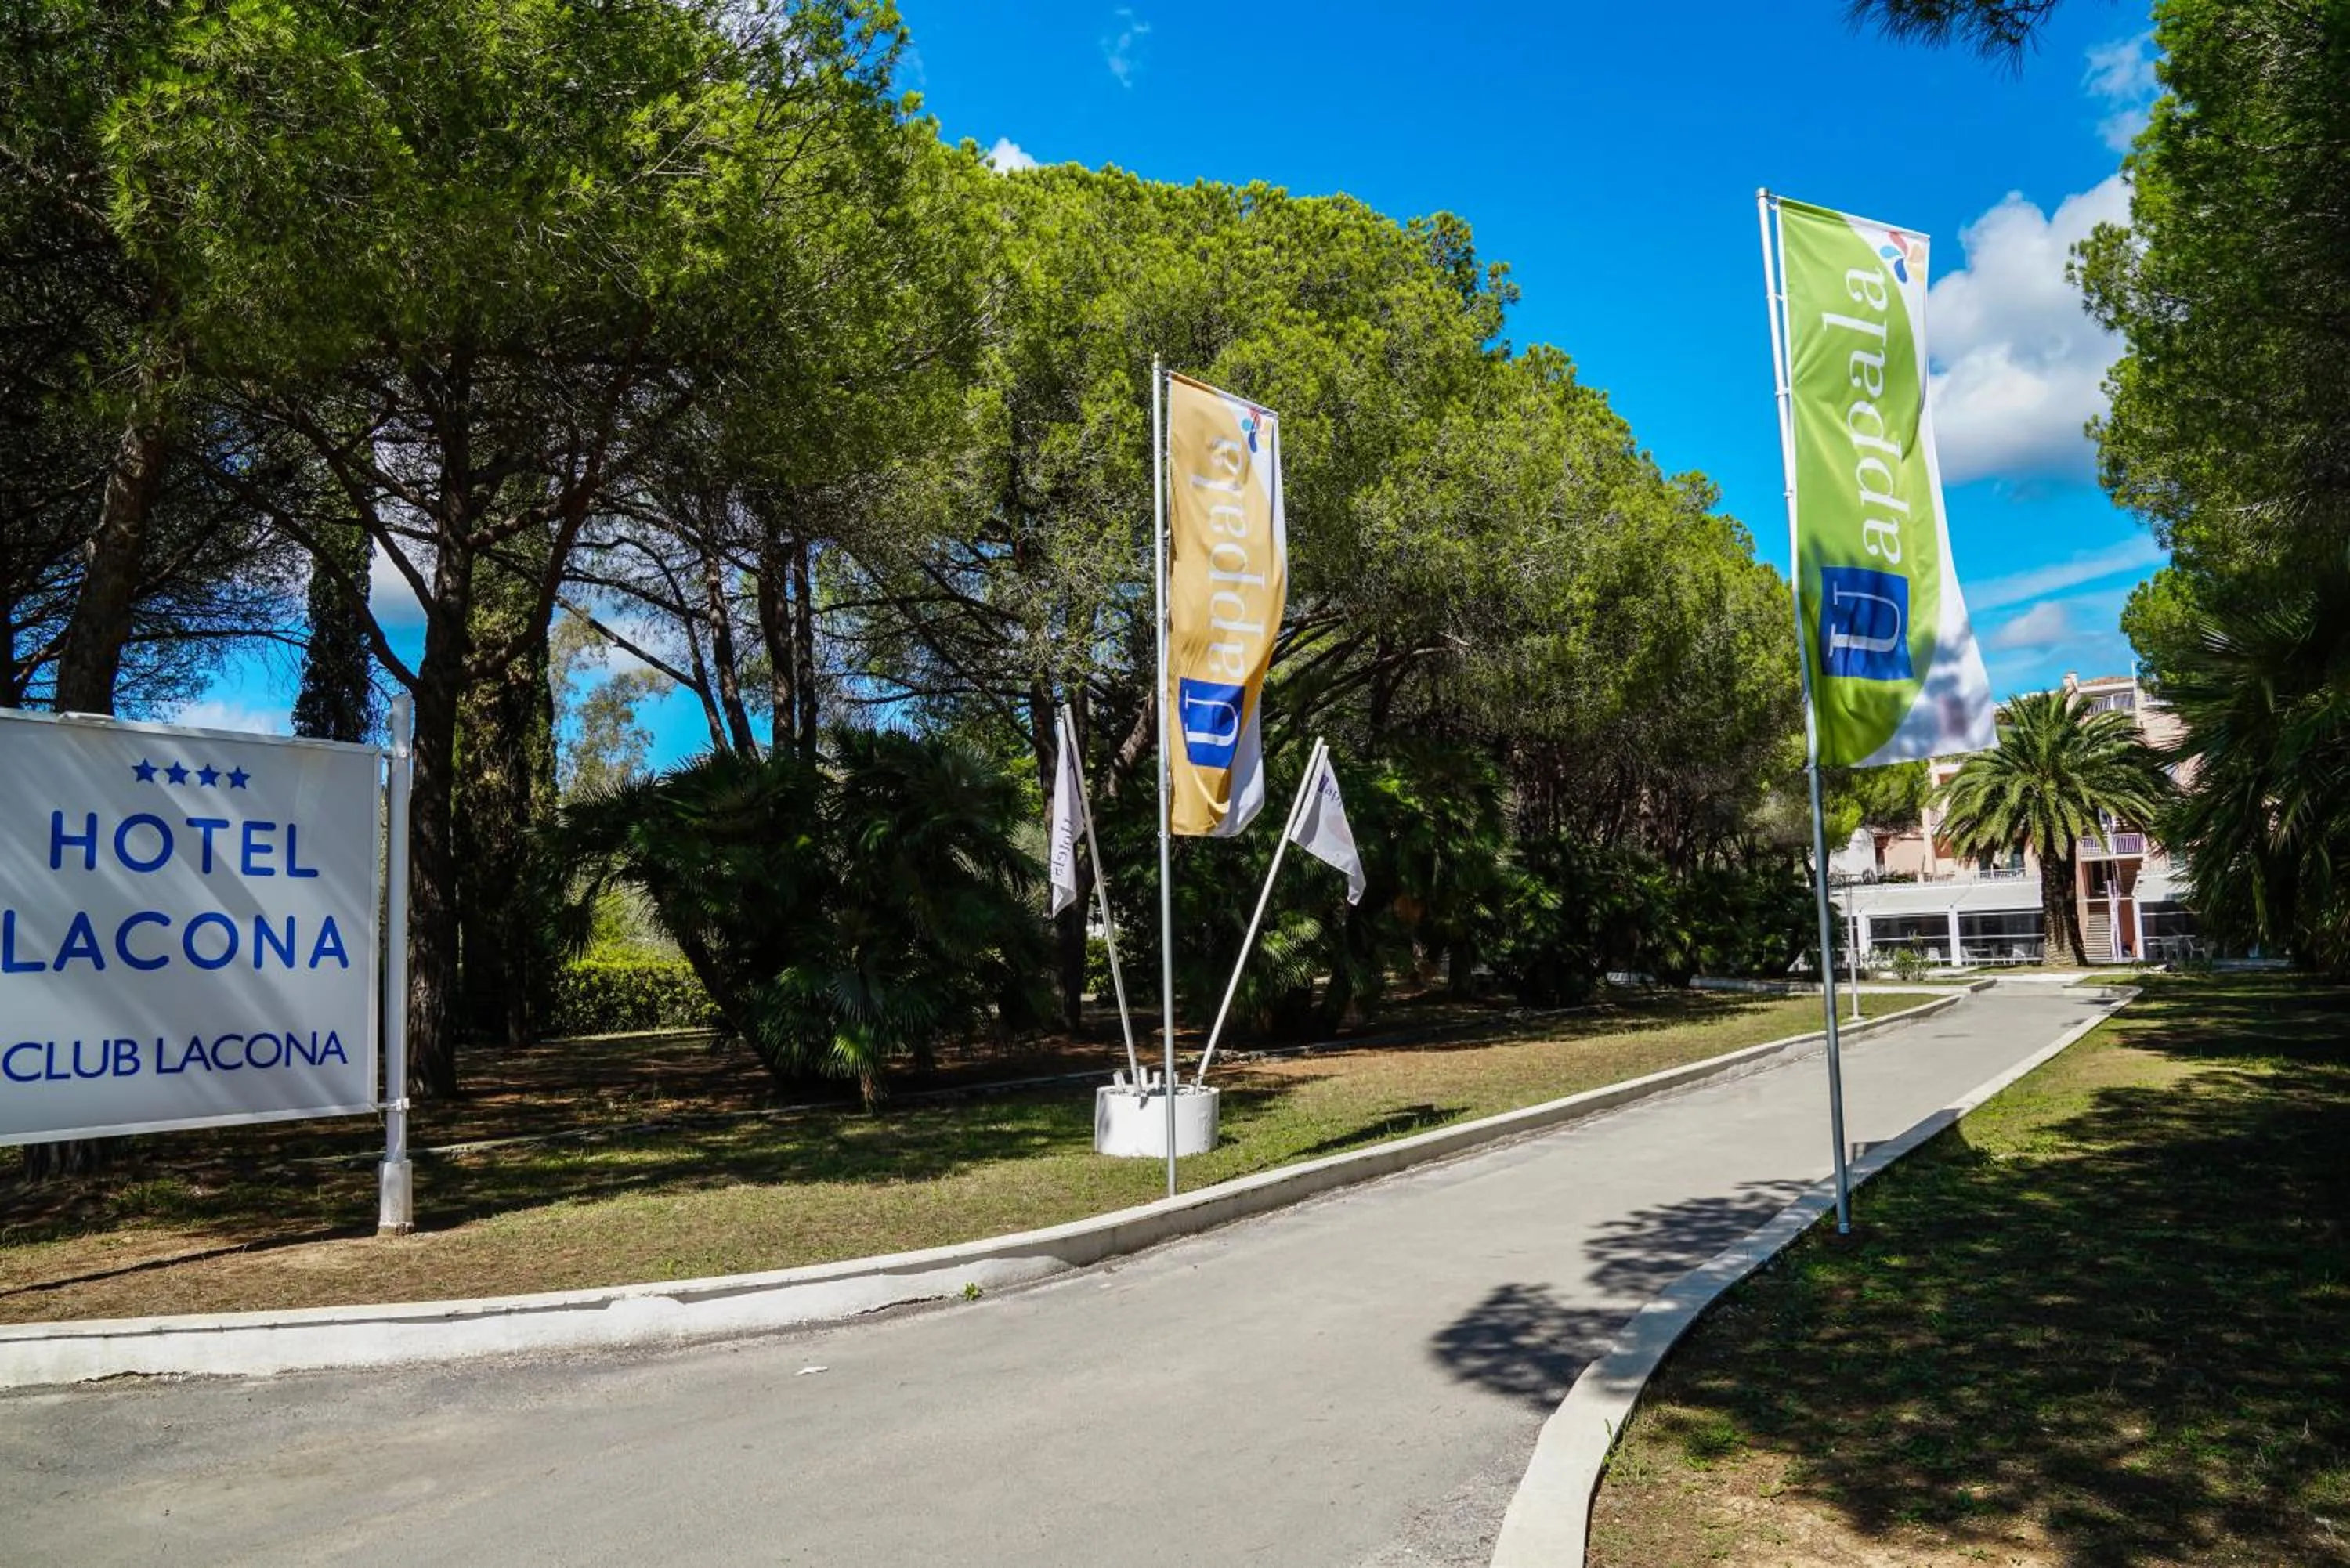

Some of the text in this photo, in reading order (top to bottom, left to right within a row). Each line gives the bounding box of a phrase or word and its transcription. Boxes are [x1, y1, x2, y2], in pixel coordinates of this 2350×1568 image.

[49, 811, 319, 878] HOTEL
[2, 909, 349, 973] LACONA
[2, 1031, 348, 1082] CLUB LACONA
